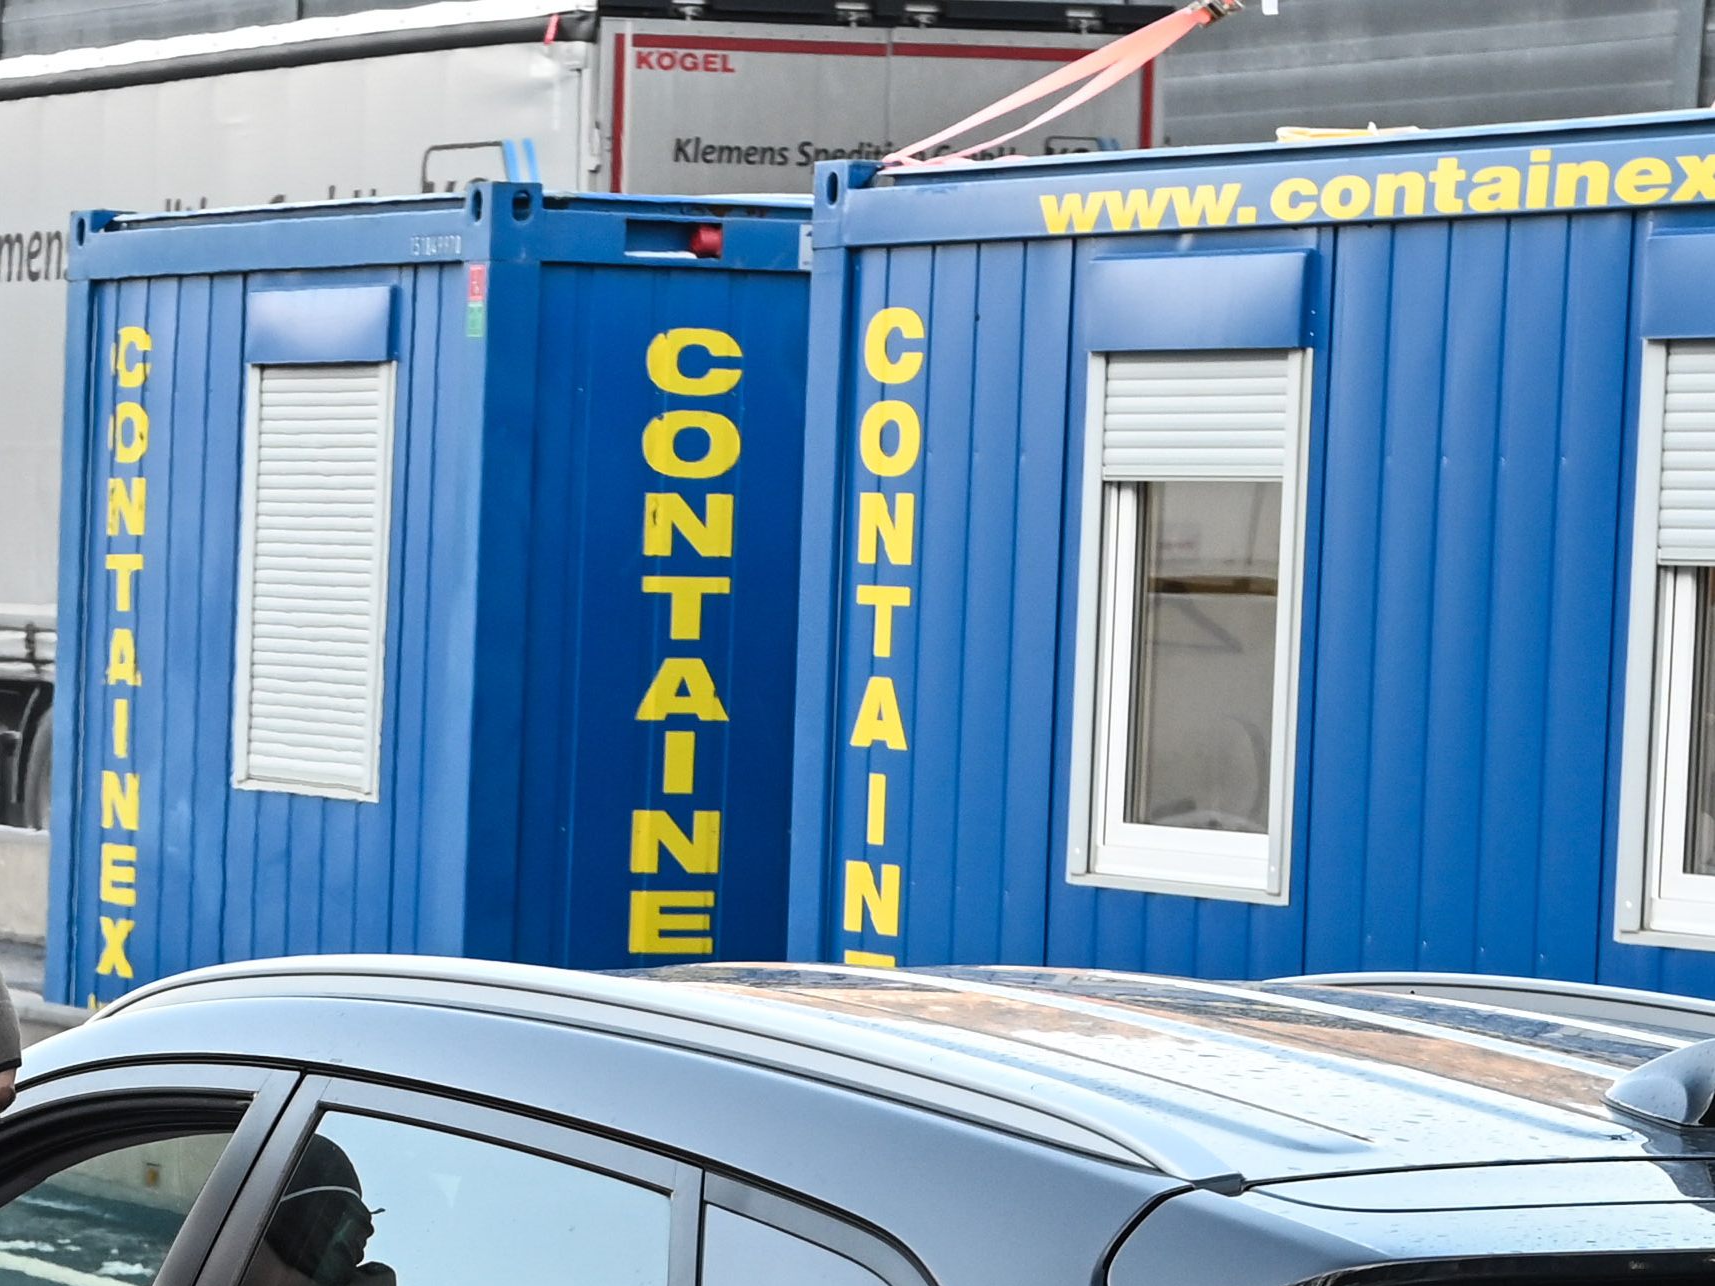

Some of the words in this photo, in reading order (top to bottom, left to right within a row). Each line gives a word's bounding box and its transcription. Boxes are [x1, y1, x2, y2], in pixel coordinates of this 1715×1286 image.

[673, 137, 788, 165] Klemens
[95, 326, 152, 979] CONTAINEX
[843, 307, 924, 967] CONTAIN
